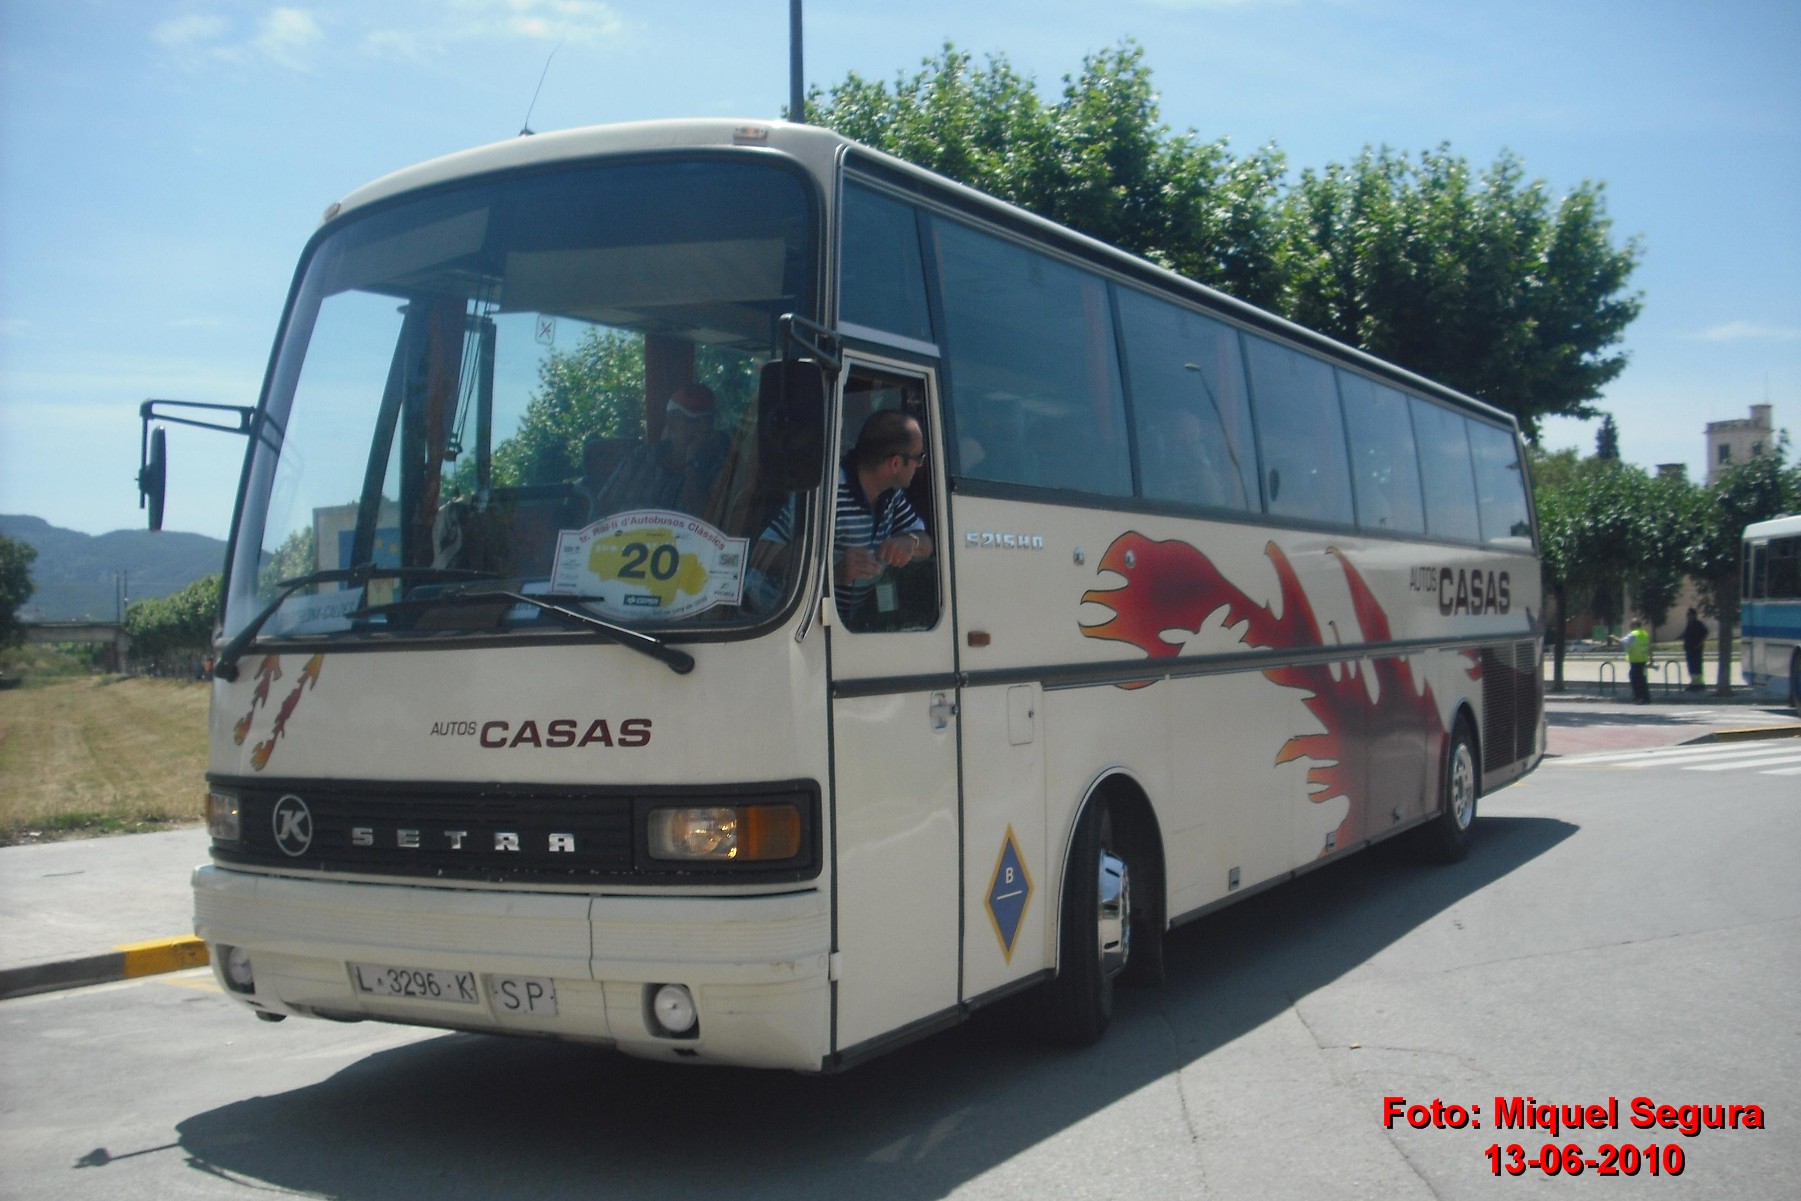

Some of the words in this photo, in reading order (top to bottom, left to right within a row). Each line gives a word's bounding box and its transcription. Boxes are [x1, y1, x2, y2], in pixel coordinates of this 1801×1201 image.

[617, 542, 680, 580] 20
[1409, 566, 1437, 592] AUTOS
[1439, 567, 1510, 616] CASAS
[430, 721, 477, 736] AUTOS
[480, 718, 653, 748] CASAS
[352, 827, 575, 852] SETRA
[1006, 867, 1014, 884] B
